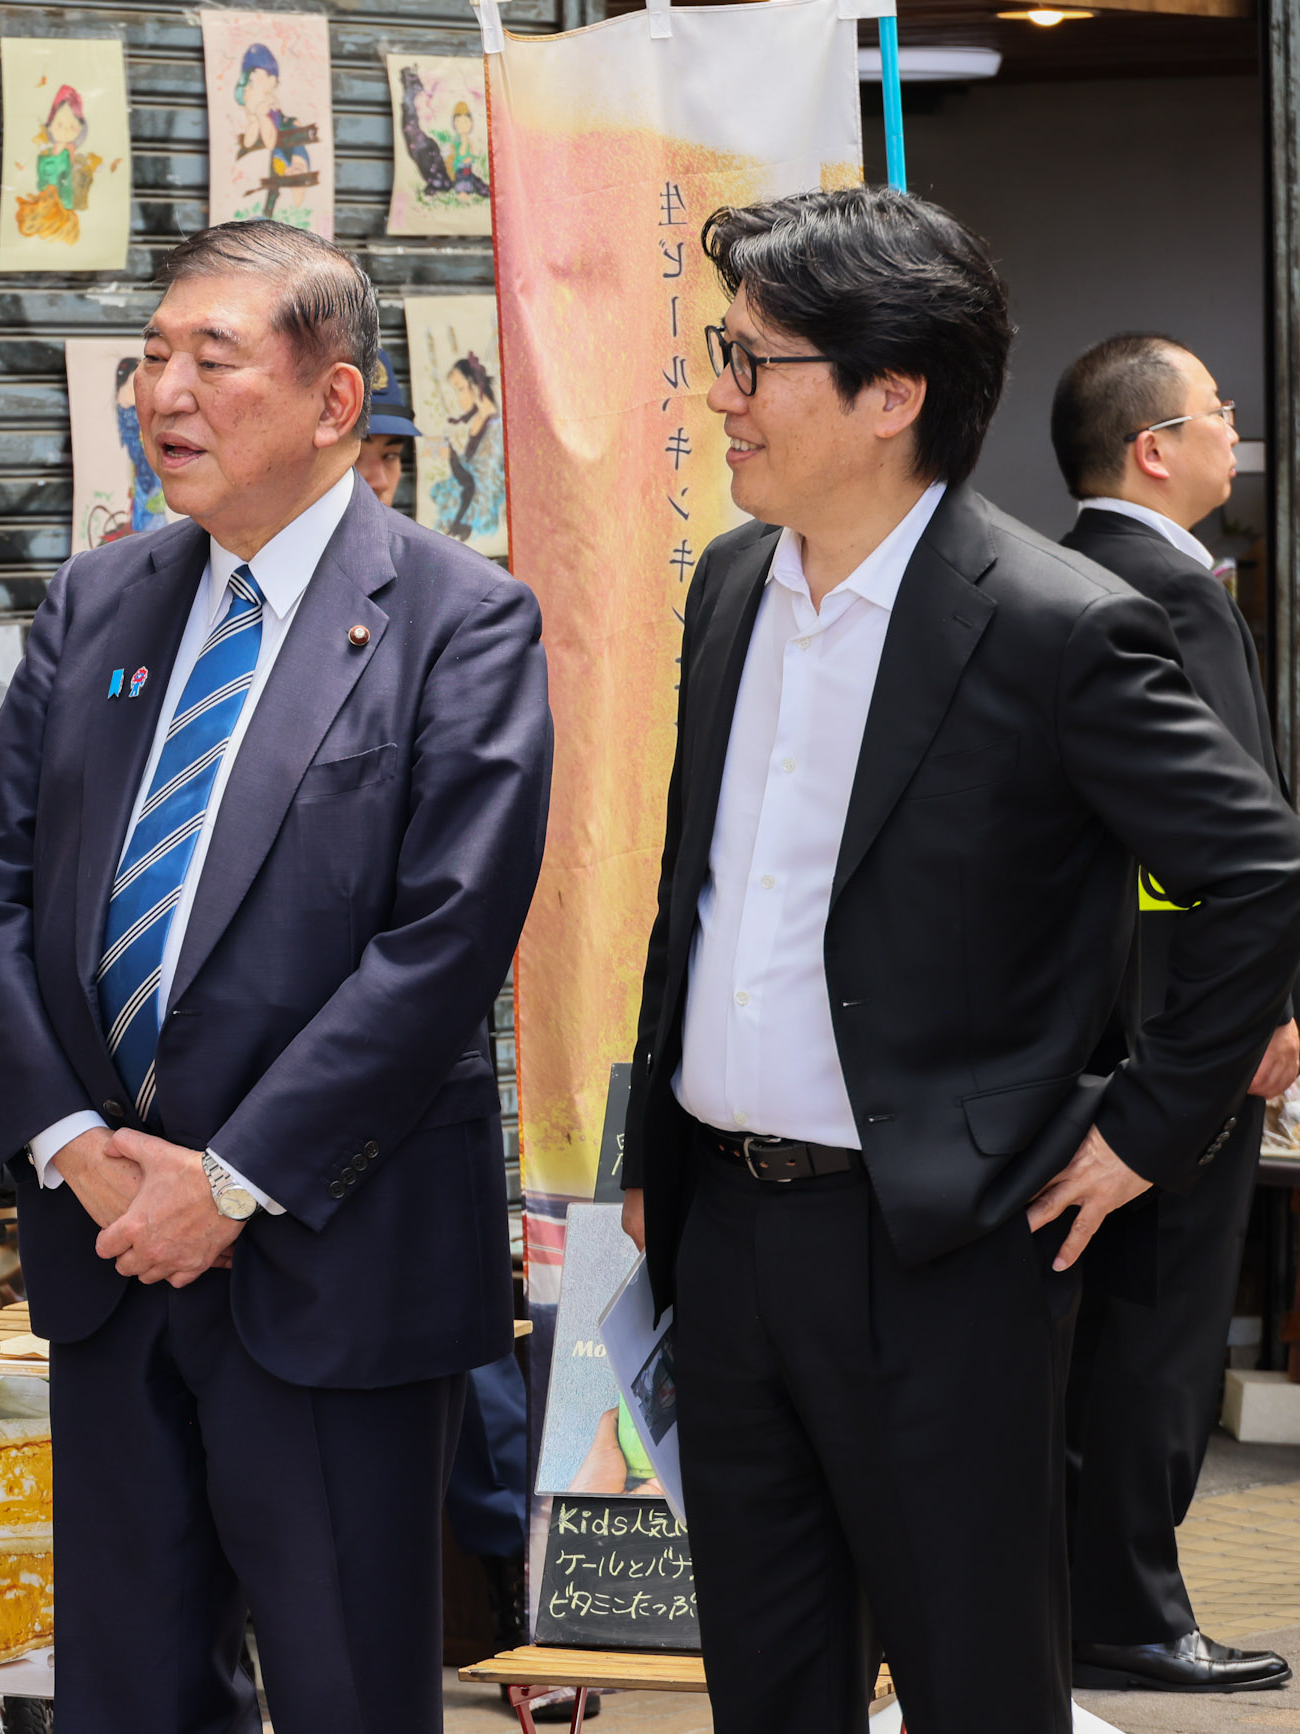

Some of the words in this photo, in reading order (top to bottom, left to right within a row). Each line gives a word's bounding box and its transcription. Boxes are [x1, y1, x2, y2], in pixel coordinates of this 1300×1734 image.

[556, 1546, 694, 1581] ケールとバナ
